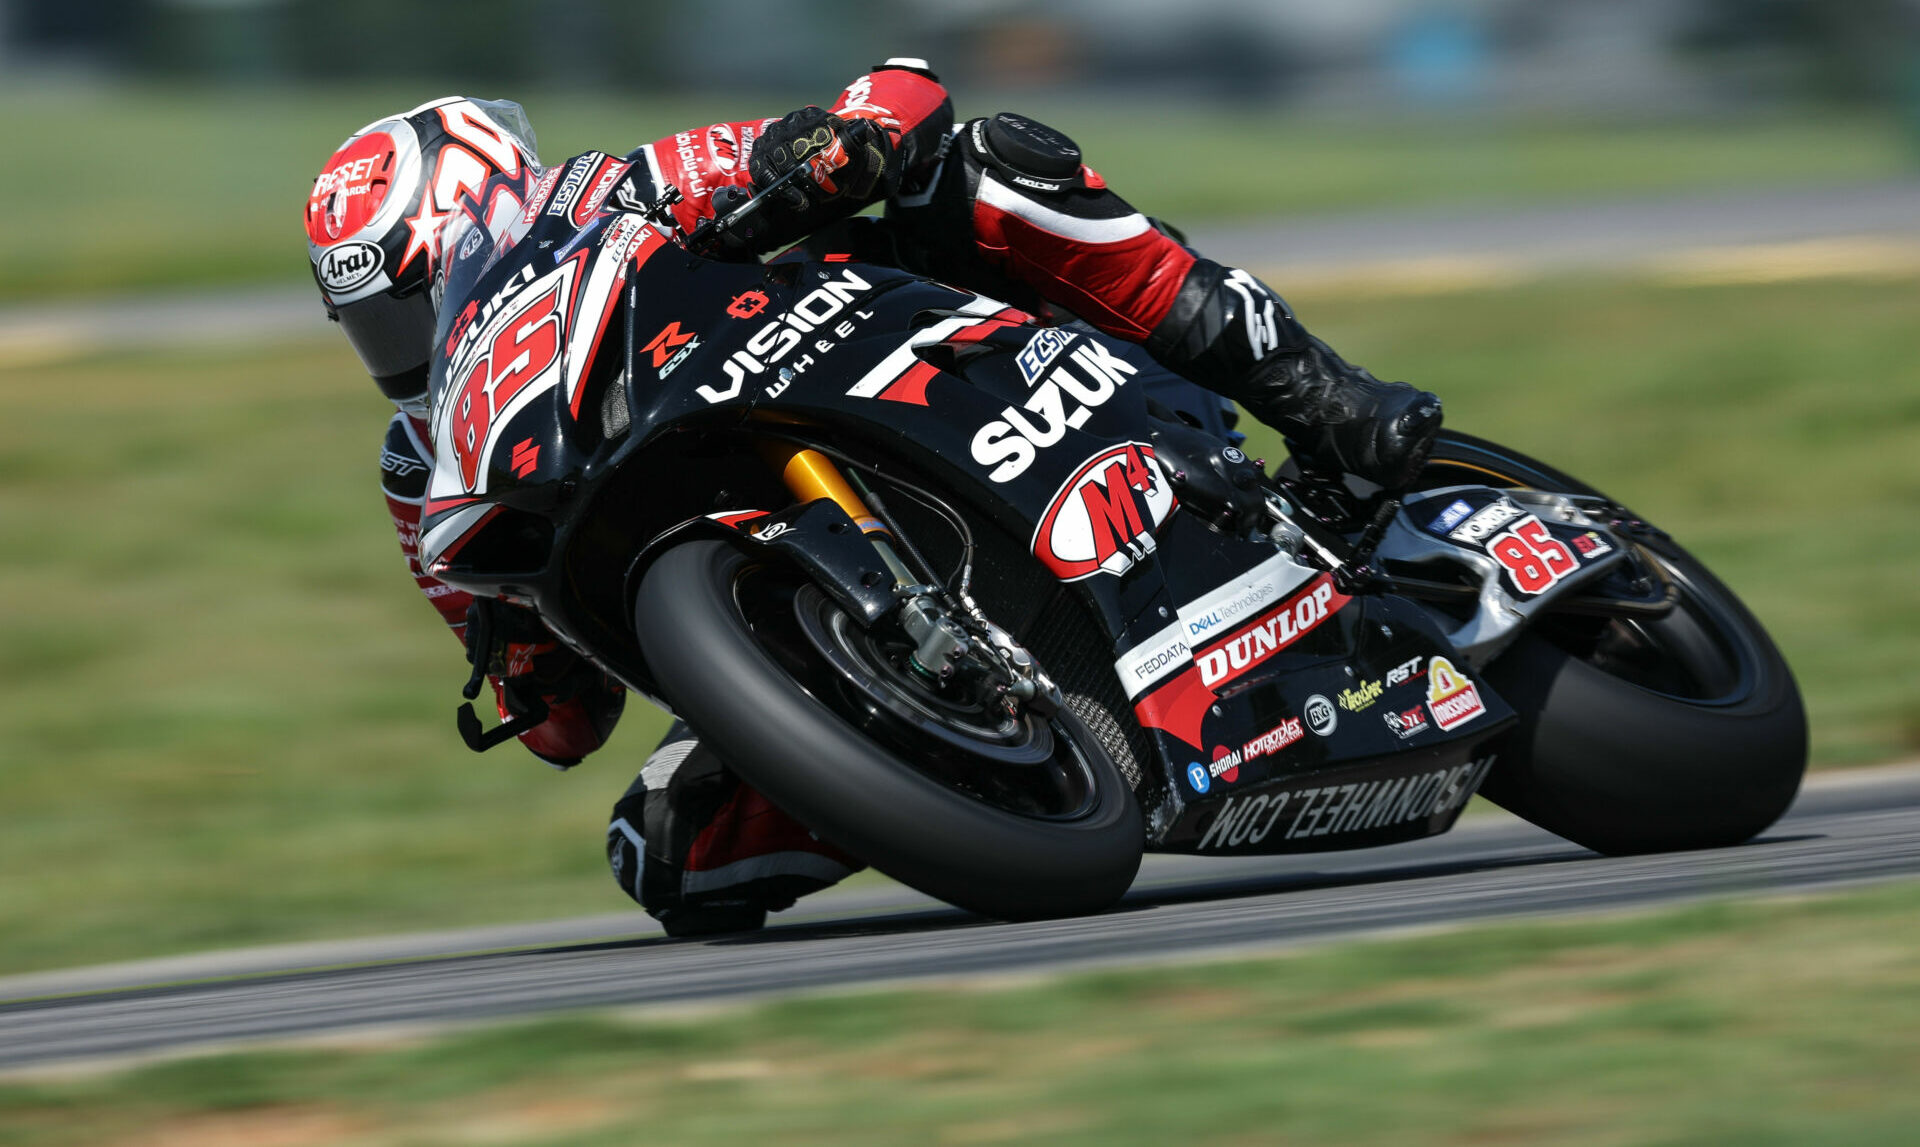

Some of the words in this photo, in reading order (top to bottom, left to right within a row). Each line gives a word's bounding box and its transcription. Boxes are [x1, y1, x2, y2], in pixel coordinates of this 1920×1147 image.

[312, 154, 381, 198] RESET
[1012, 177, 1060, 191] FACTORY
[323, 244, 373, 284] Arai
[612, 224, 637, 262] ECSTAR
[431, 263, 536, 437] SUZUKI
[658, 334, 701, 380] GSX
[695, 268, 873, 404] VISION
[765, 309, 874, 399] WHEEL
[451, 276, 563, 494] 85
[1079, 443, 1154, 566] M4
[1486, 515, 1581, 595] 85
[1189, 612, 1222, 636] DELL
[1220, 583, 1274, 619] Technologies
[1196, 582, 1333, 688] DUNLOP
[1135, 642, 1189, 680] FEDDATA
[1386, 655, 1423, 688] RST
[1209, 749, 1243, 779] SHORAI
[1197, 754, 1498, 850] VISIONWHEEL.COM
